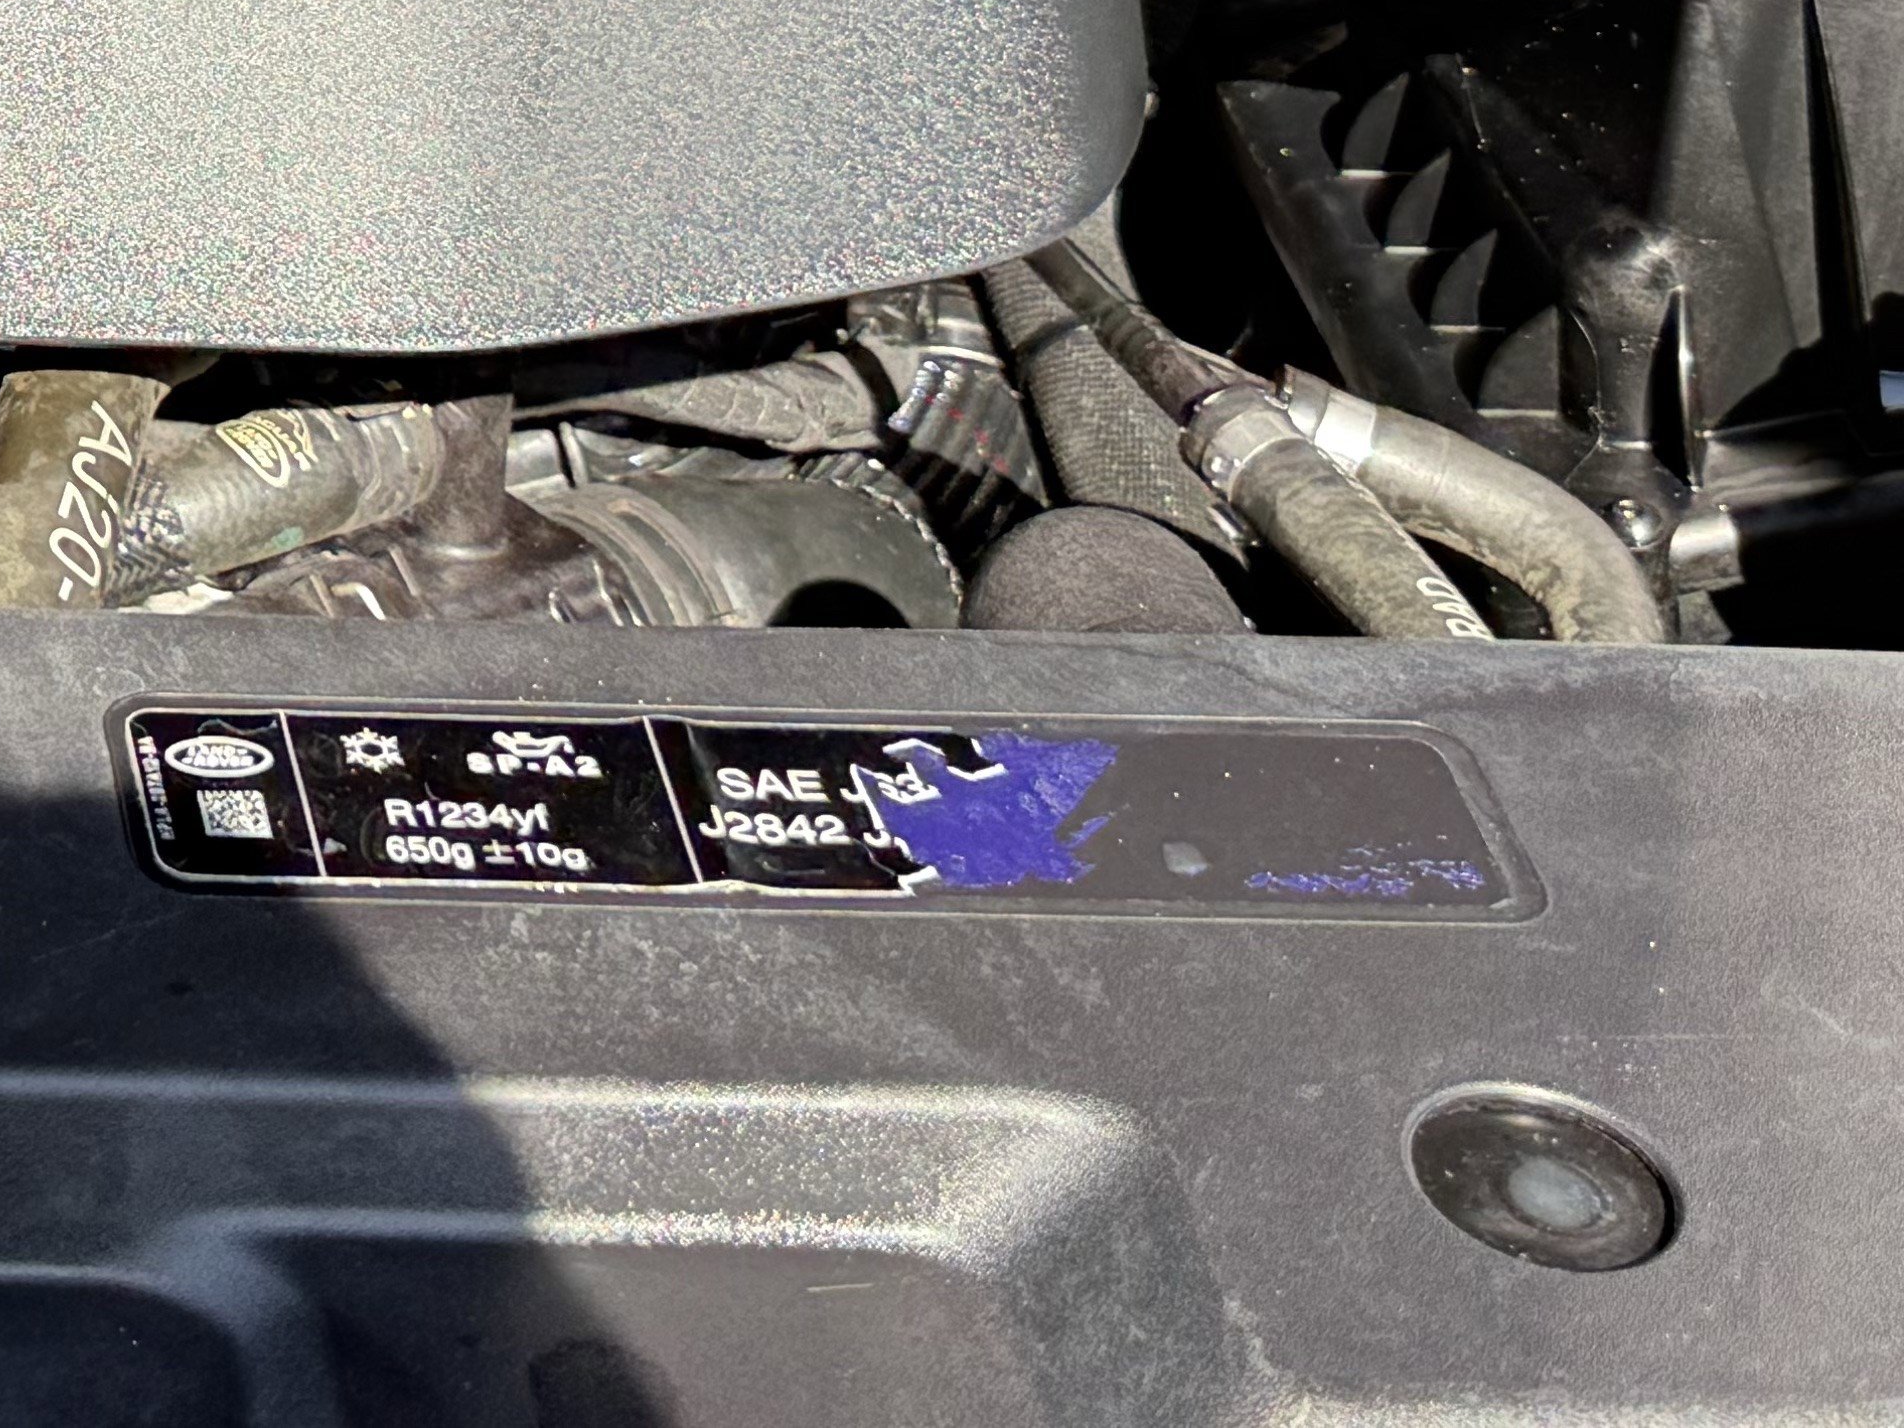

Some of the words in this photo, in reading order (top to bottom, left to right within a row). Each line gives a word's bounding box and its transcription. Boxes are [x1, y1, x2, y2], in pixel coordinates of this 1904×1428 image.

[466, 752, 602, 778] SP-A2
[716, 767, 831, 802] SAE
[384, 798, 550, 836] R1234yf
[699, 805, 850, 844] J2842
[385, 835, 476, 871] 650g
